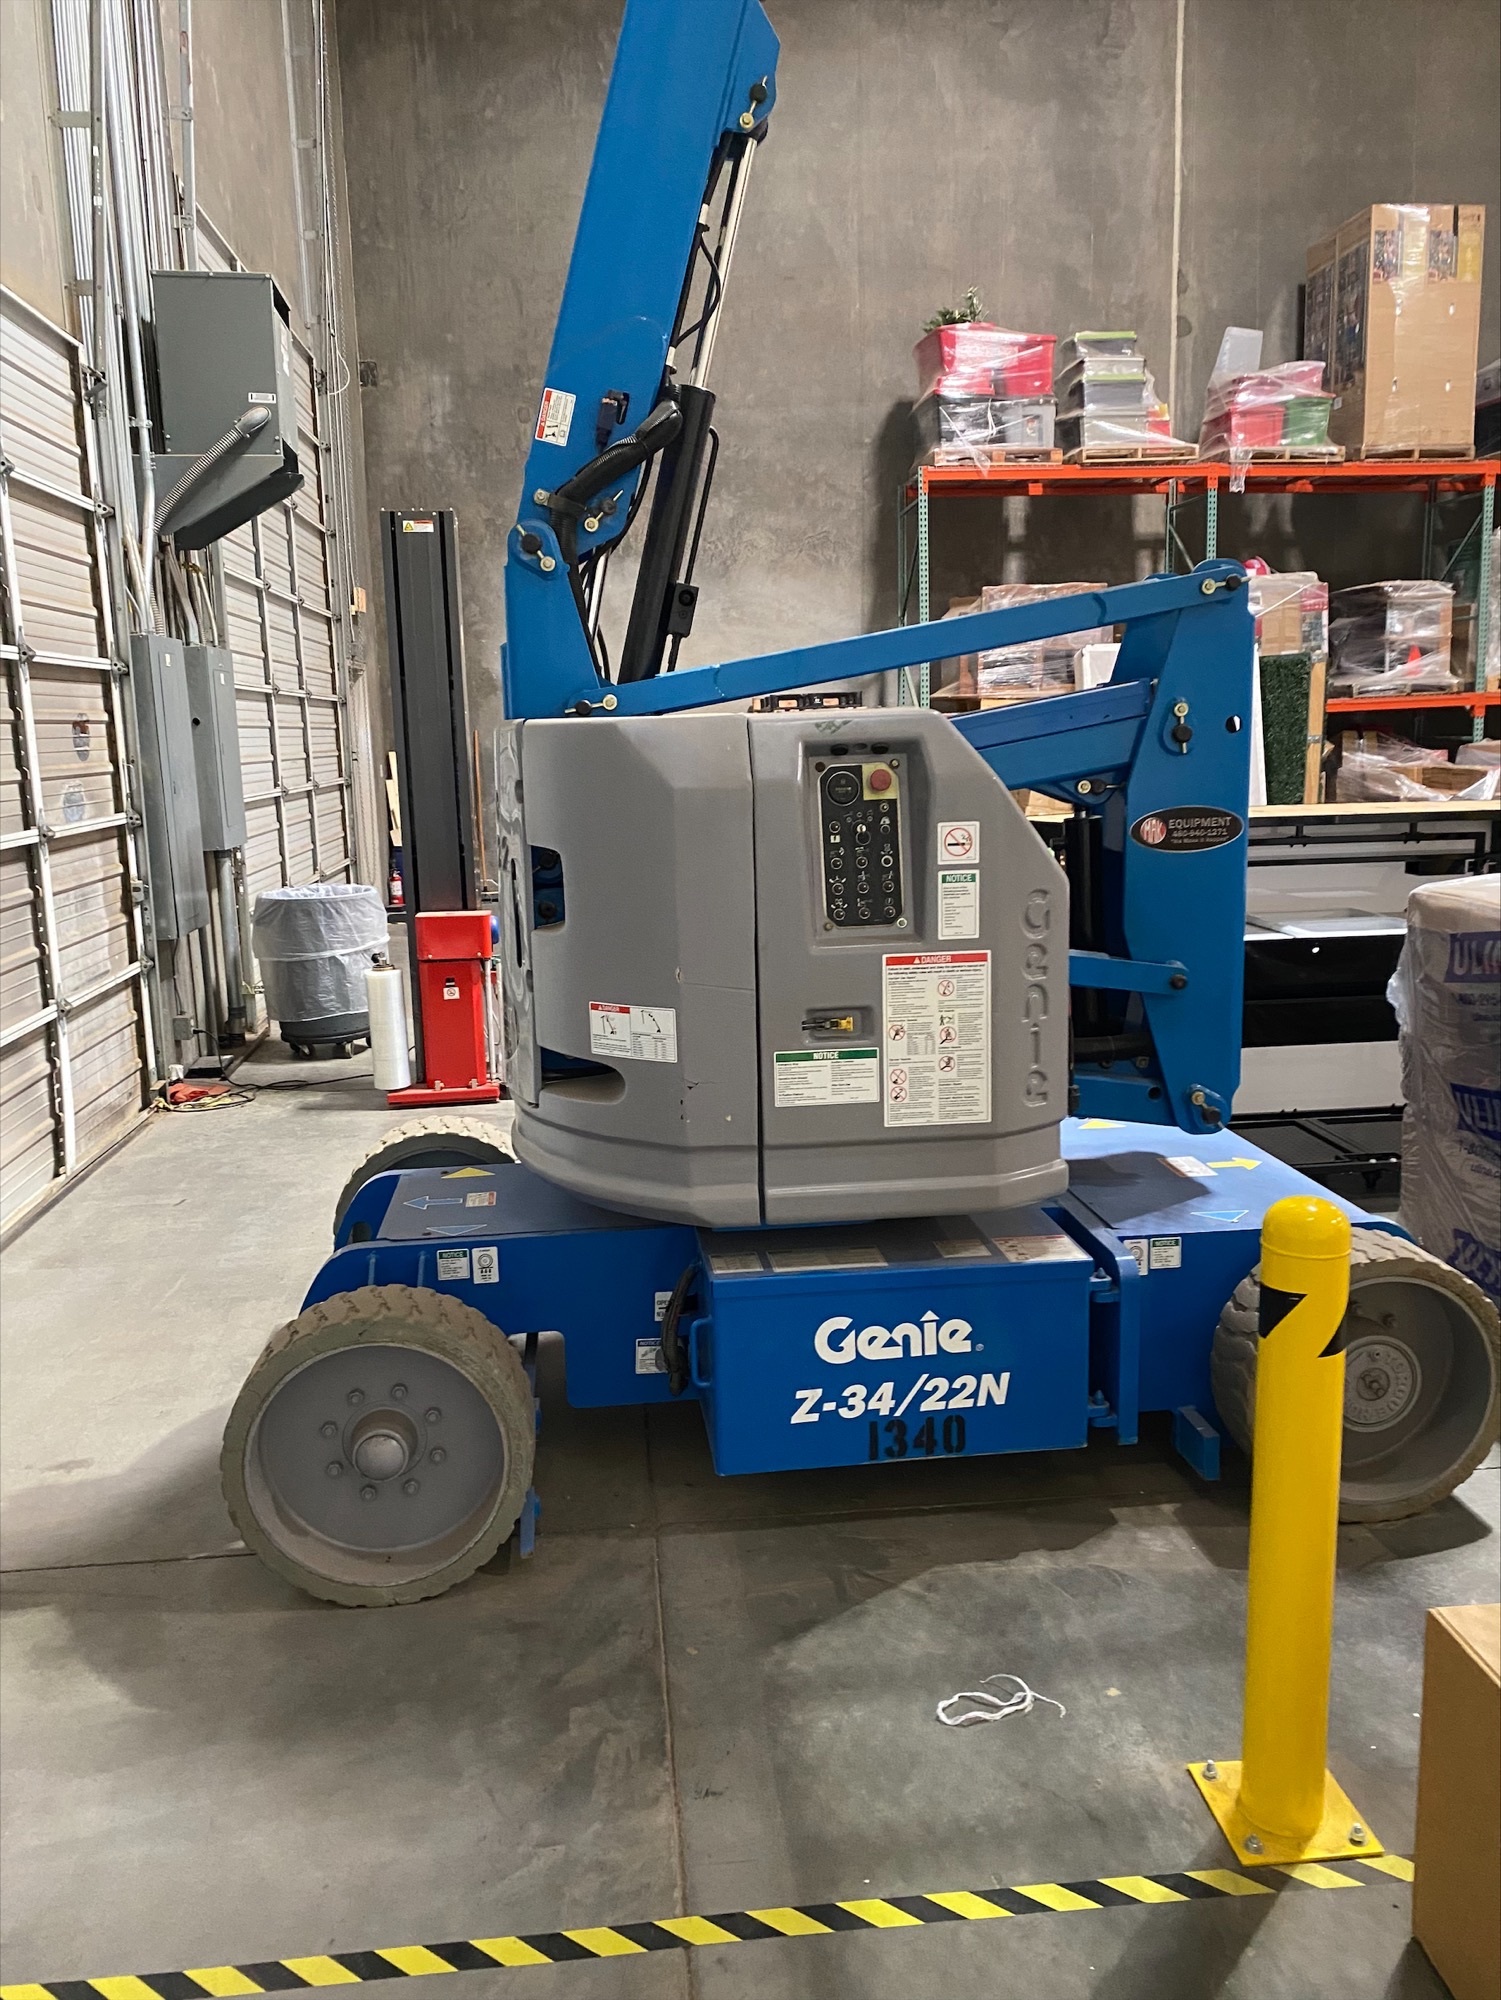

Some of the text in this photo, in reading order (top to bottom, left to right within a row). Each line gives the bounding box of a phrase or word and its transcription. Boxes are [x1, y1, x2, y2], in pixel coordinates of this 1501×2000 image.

[1168, 816, 1232, 829] EQUIPMENT
[945, 873, 973, 882] NOTICE
[921, 955, 952, 964] DANGER
[813, 1051, 839, 1060] NOTICE
[814, 1310, 973, 1365] Genie
[790, 1372, 1011, 1425] Z-34/22N
[868, 1414, 966, 1461] 1340
